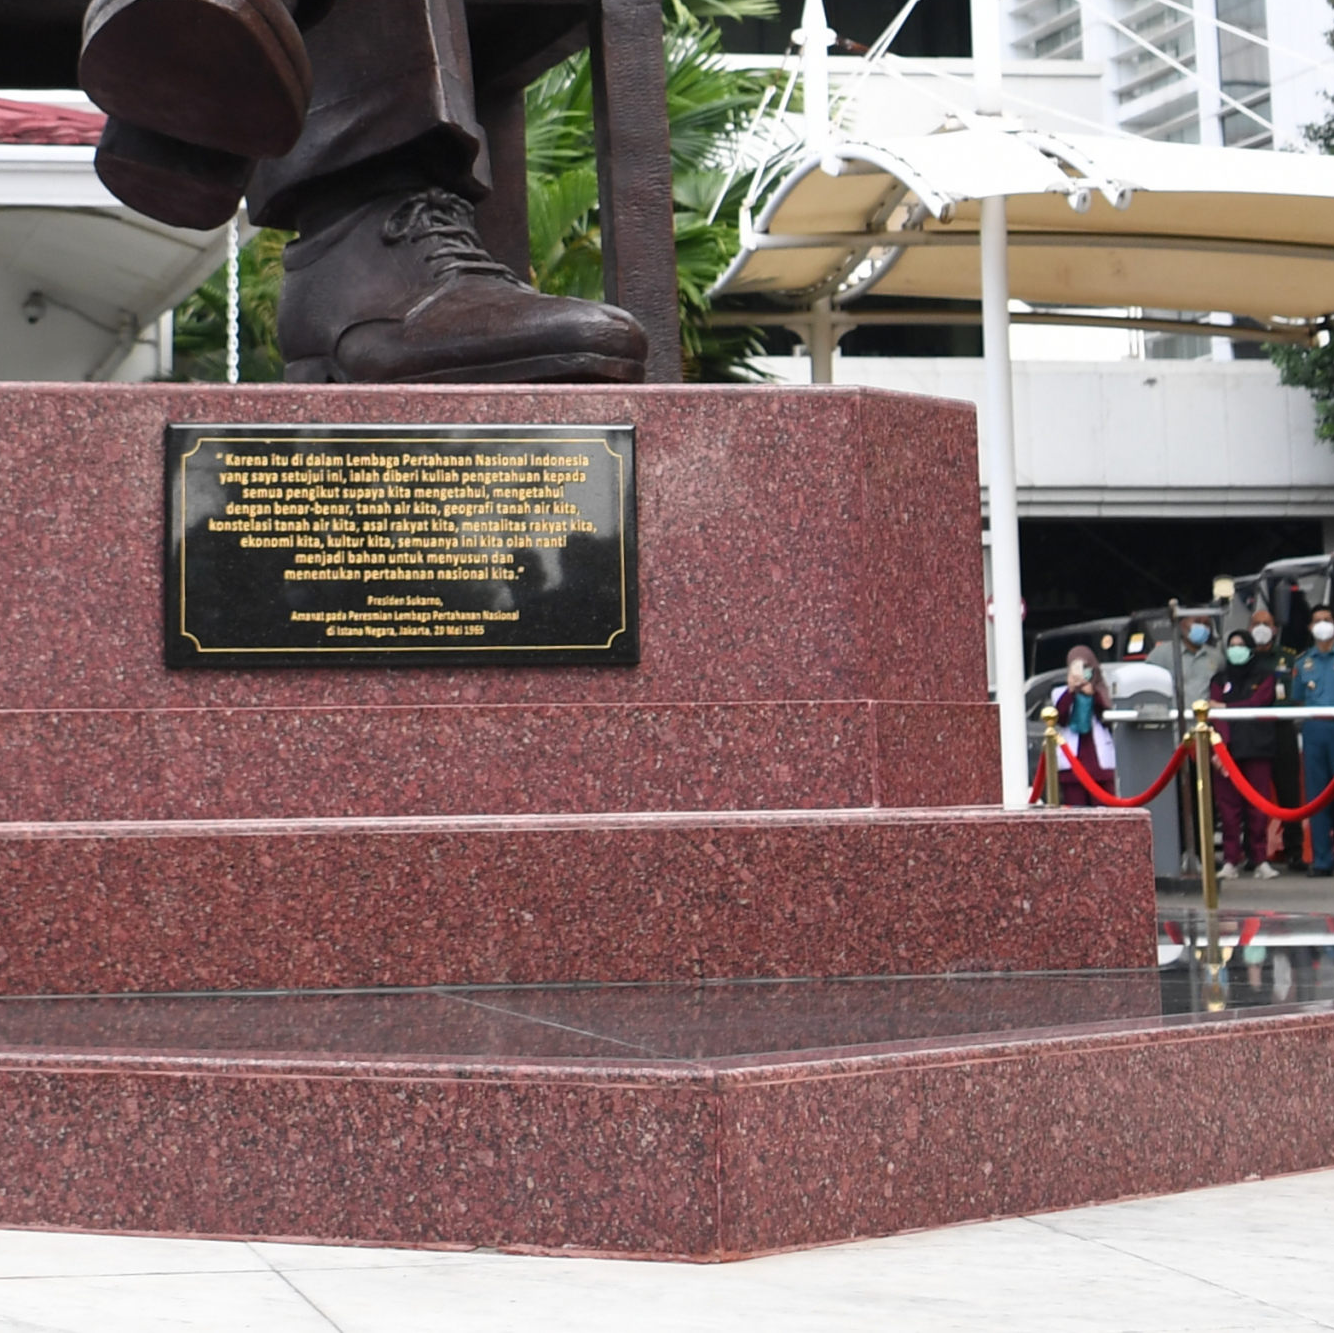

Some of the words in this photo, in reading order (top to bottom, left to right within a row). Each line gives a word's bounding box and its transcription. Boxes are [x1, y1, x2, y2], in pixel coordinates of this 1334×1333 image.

[225, 454, 268, 466] Karena
[270, 454, 289, 466] itu
[290, 454, 304, 466] di
[305, 454, 344, 466] dalam
[346, 454, 400, 469] Lembaga
[402, 454, 472, 466] Pertahanan
[474, 454, 527, 466] Nasional
[530, 454, 589, 466] Indonesia
[219, 473, 249, 485] yang
[250, 473, 278, 485] saya
[281, 470, 323, 485] setujui
[326, 470, 347, 484] ini,
[349, 470, 380, 482] ialah
[382, 470, 419, 482] diberi
[421, 470, 459, 482] kuliah
[461, 470, 540, 485] pengetahuan
[543, 470, 586, 485] kepada
[242, 489, 283, 498] semua
[285, 486, 340, 501] pengikut
[342, 489, 385, 501] supaya
[387, 486, 410, 498] kita
[414, 486, 490, 501] mengetahui,
[492, 486, 564, 501] mengetahui
[225, 502, 271, 517] dengan
[273, 502, 353, 516] benar-benar,
[356, 502, 391, 514] tanah
[394, 502, 411, 514] air
[413, 502, 441, 516] kita,
[443, 502, 494, 517] geografi
[496, 502, 531, 514] tanah
[534, 502, 551, 514] air
[553, 502, 580, 516] kita,
[208, 518, 272, 530] konstelasi
[274, 518, 310, 530] tanah
[312, 518, 330, 530] air
[332, 518, 360, 533] kita,
[362, 518, 388, 530] asal
[390, 518, 428, 534] rakyat
[431, 518, 459, 533] kita,
[461, 518, 527, 530] mentalitas
[529, 518, 567, 534] rakyat
[570, 518, 598, 533] kita,
[240, 535, 294, 547] ekonomi
[296, 535, 324, 549] kita,
[326, 535, 365, 547] kultur
[367, 535, 395, 549] kita,
[397, 538, 459, 550] semuanya
[461, 535, 477, 547] ini
[479, 535, 503, 547] kita
[506, 535, 532, 547] olah
[535, 535, 567, 547] nanti
[295, 551, 345, 566] menjadi
[347, 551, 386, 563] bahan
[388, 551, 424, 563] untuk
[426, 554, 488, 566] menyusun
[491, 551, 514, 563] dan
[283, 568, 361, 579] menentukan
[363, 568, 434, 582] pertahanan
[437, 568, 489, 579] nasional
[367, 596, 405, 606] Presiden
[290, 611, 325, 620] Amanat
[325, 611, 347, 622] pada
[348, 611, 393, 620] Peresmian
[393, 611, 431, 622] Lembaga
[432, 611, 481, 620] Pertahanan
[482, 611, 519, 620] Nasional
[325, 626, 336, 635] di
[337, 626, 363, 635] Istana
[446, 626, 462, 635] Mei
